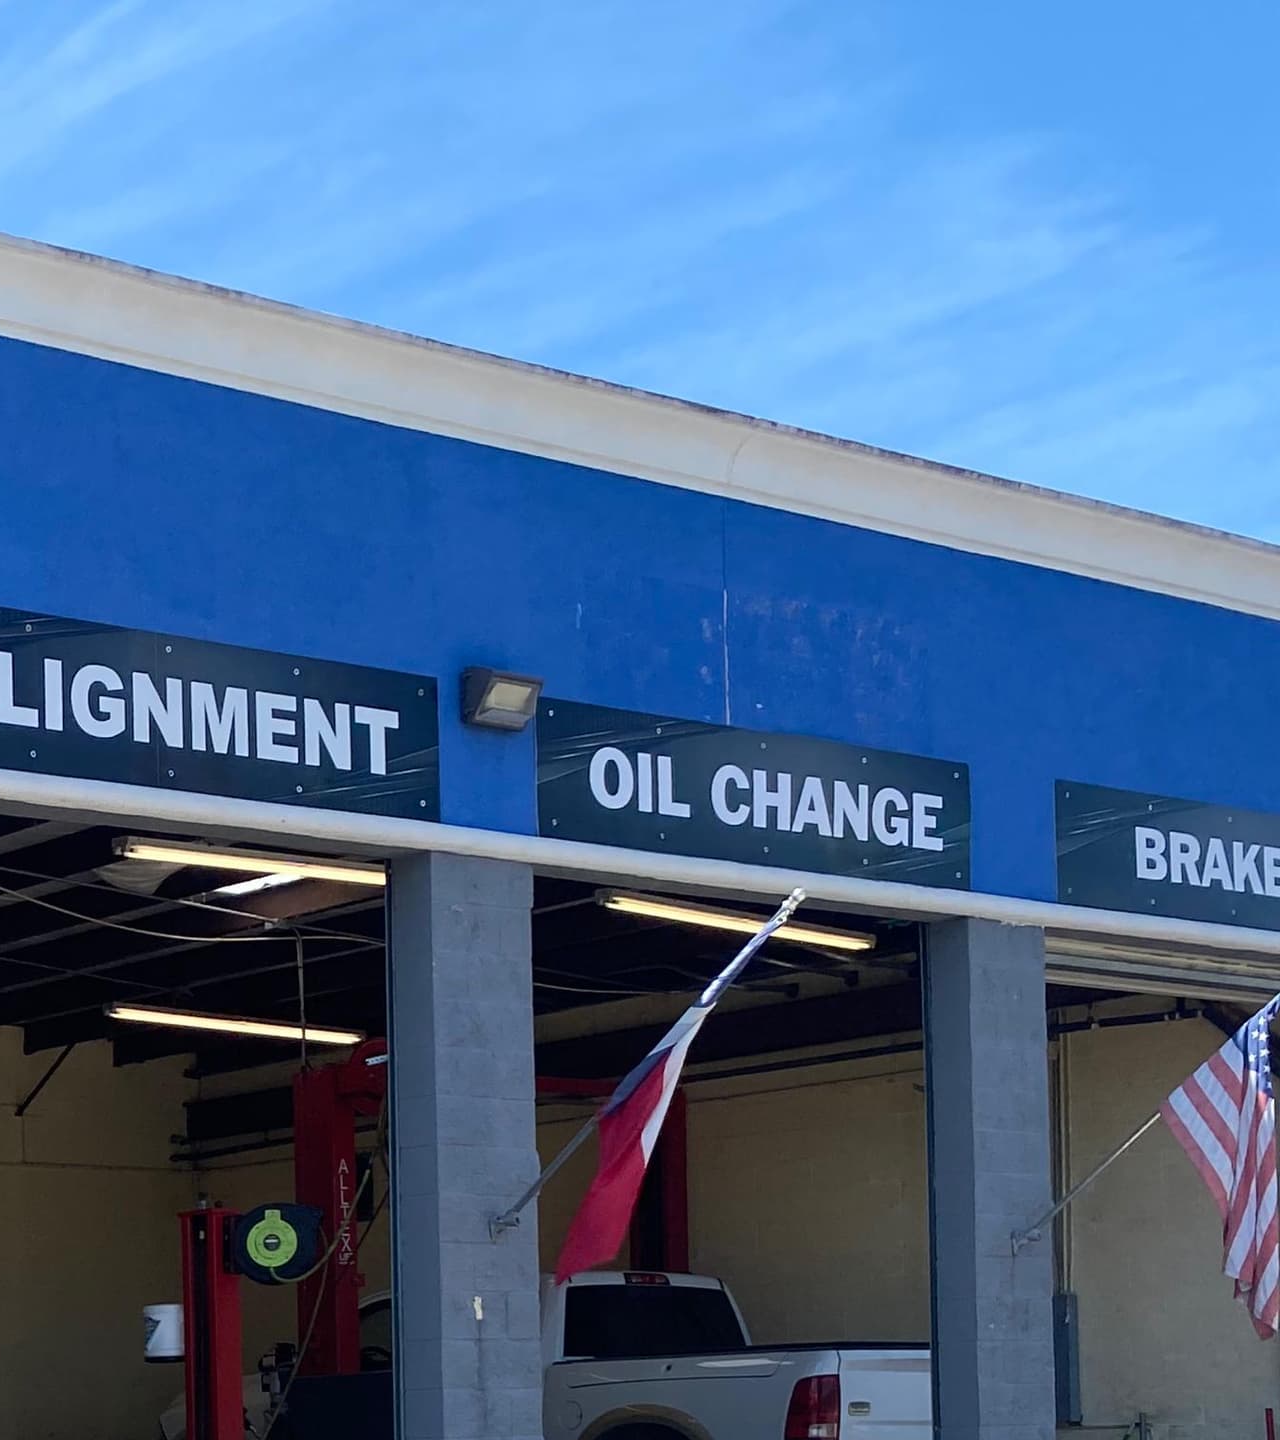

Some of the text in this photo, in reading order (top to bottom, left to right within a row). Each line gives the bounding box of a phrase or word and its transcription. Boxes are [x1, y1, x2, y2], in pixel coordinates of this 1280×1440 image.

[588, 746, 944, 851] OIL CHANGE
[1135, 826, 1280, 897] BRAKE
